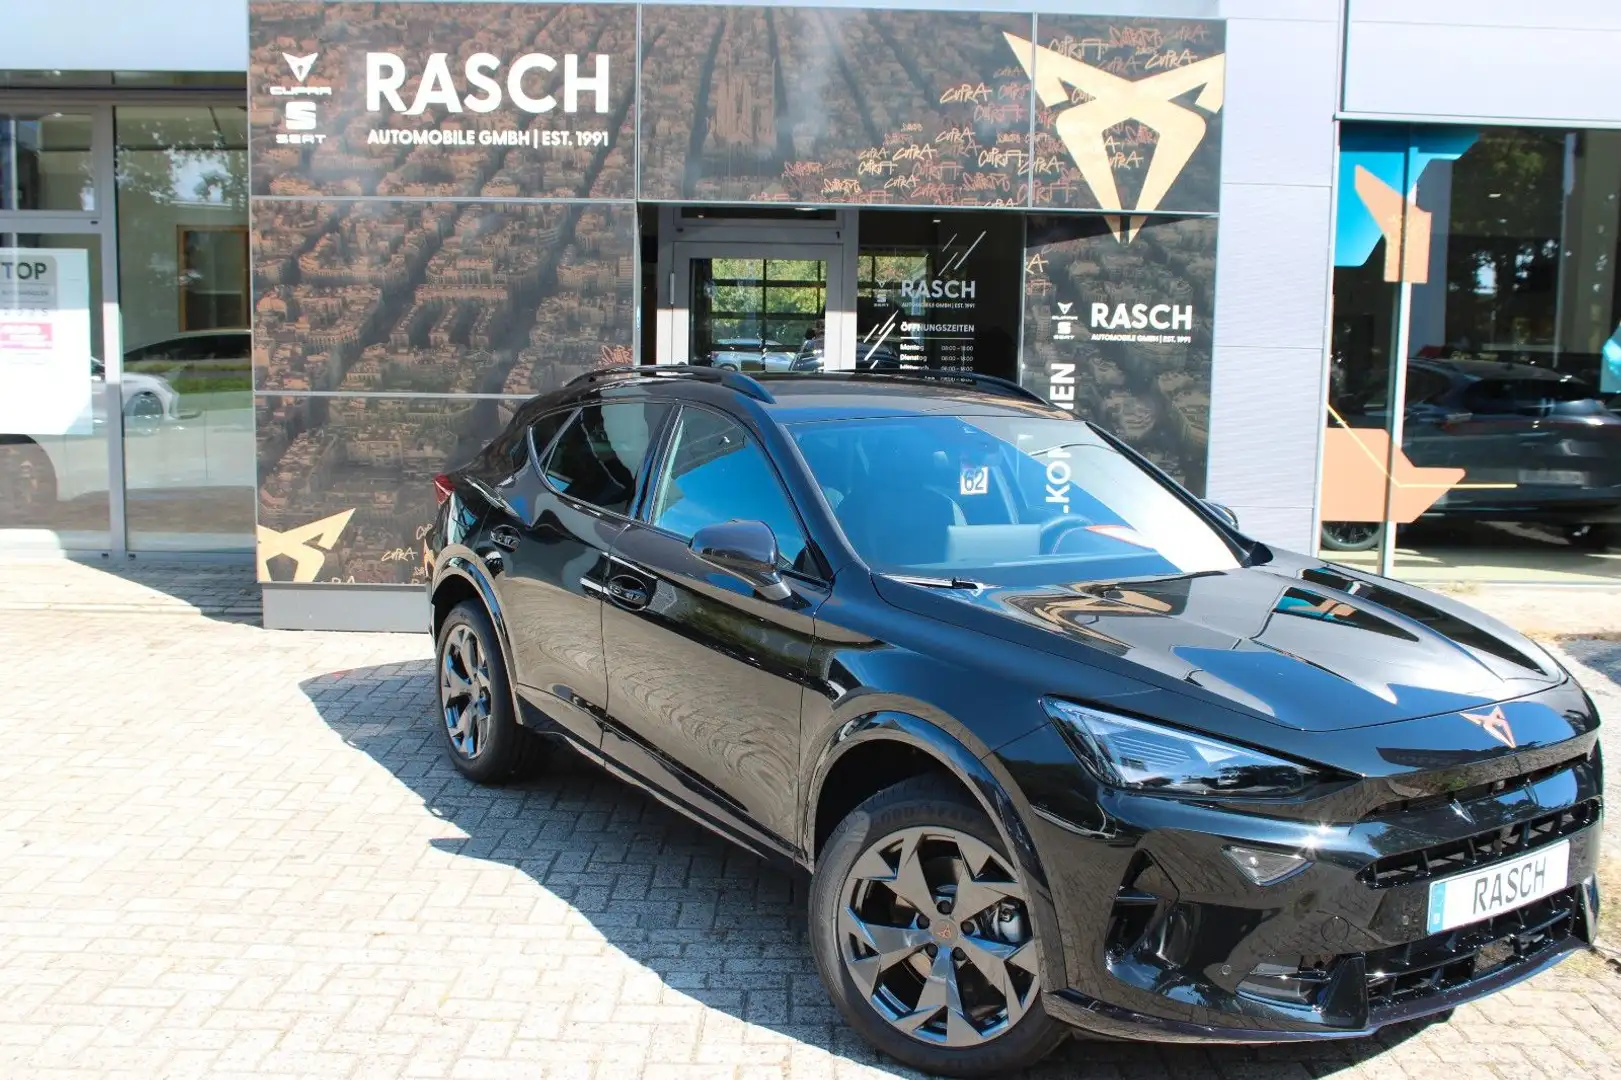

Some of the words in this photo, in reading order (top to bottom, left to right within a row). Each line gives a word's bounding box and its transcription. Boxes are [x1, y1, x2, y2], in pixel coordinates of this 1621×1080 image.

[1145, 48, 1197, 70] CUPRA
[366, 52, 609, 115] RASCH
[940, 82, 992, 104] CUPRA
[367, 129, 475, 145] AUTOMOBILE
[479, 130, 530, 146] GMBH
[542, 130, 573, 146] EST.
[576, 131, 608, 147] 1991
[936, 127, 976, 142] CUPRA
[892, 143, 938, 160] CUPRA
[884, 175, 920, 189] CUPRA
[902, 280, 976, 298] RASCH
[1091, 302, 1192, 330] RASCH
[381, 547, 418, 562] CUPRA
[1472, 856, 1548, 915] RASCH
